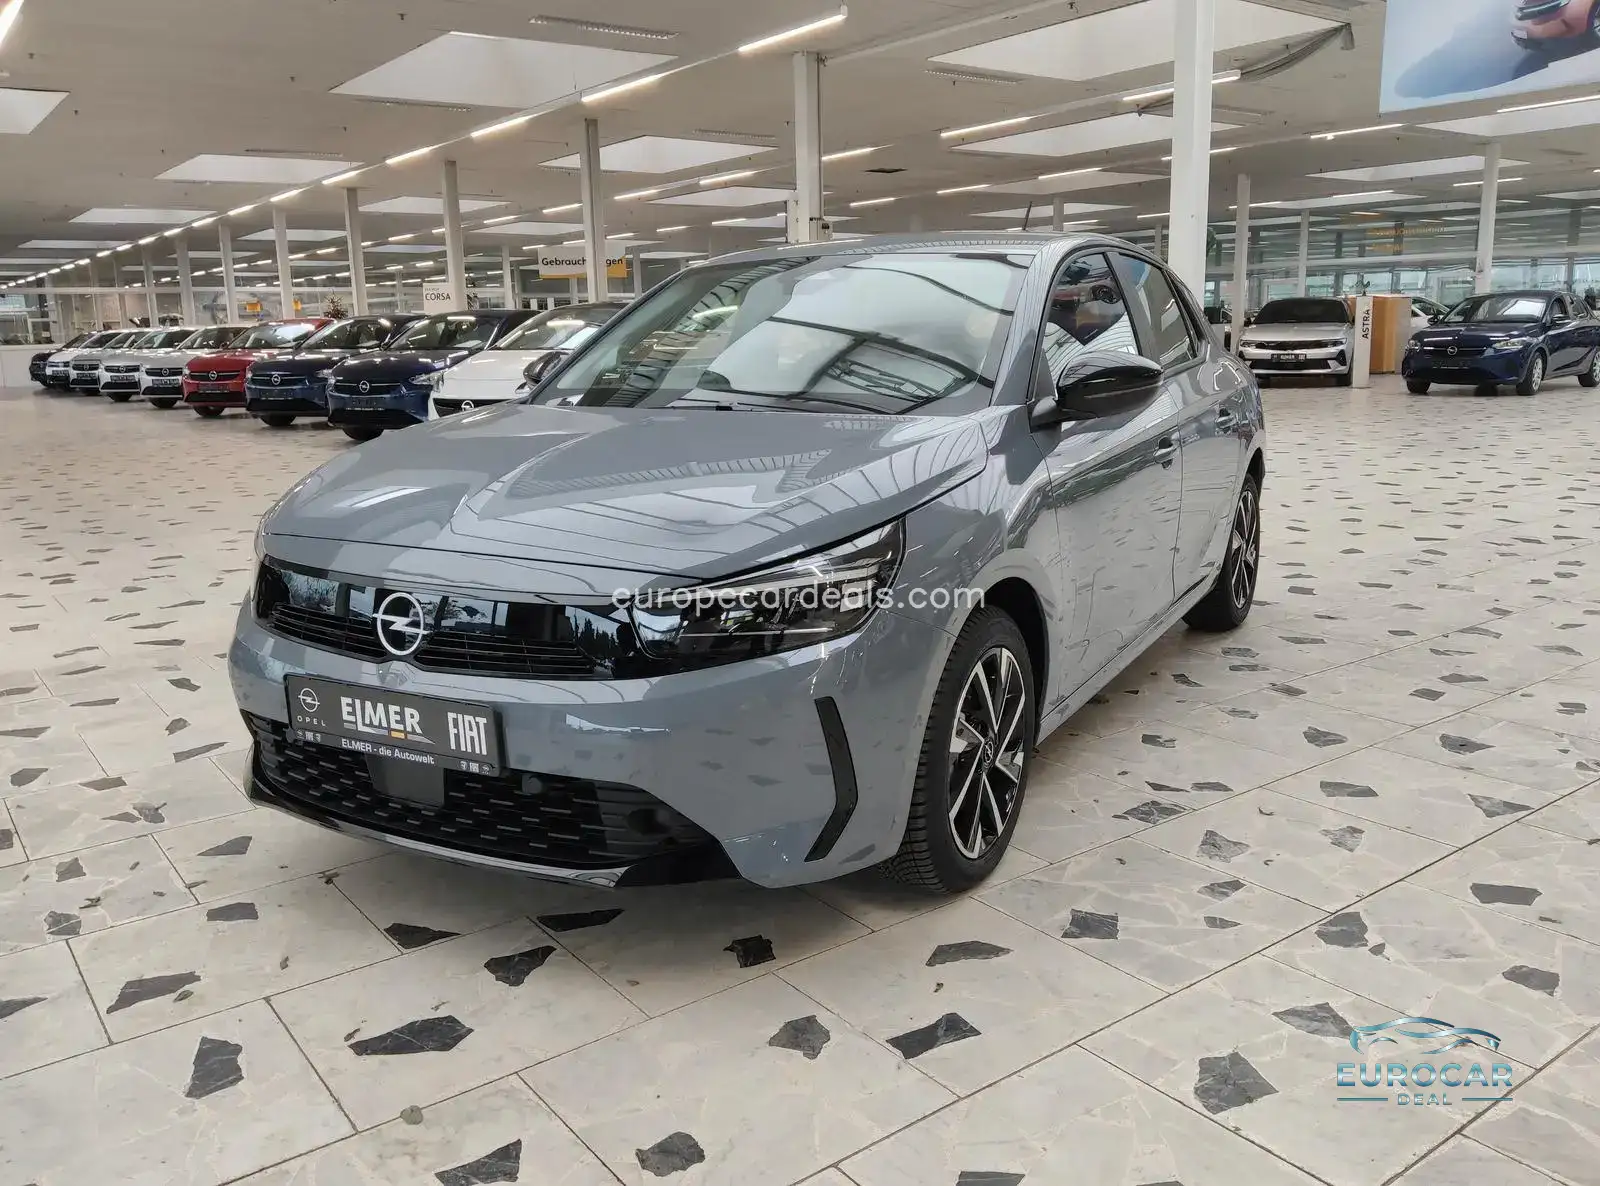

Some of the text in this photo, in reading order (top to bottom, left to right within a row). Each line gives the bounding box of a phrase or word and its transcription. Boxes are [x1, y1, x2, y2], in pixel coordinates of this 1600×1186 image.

[425, 292, 451, 301] CORSA
[1361, 309, 1371, 340] ASTRA
[297, 715, 326, 727] OPEL
[340, 696, 423, 735] ELMER
[446, 711, 488, 756] FIAT
[341, 738, 372, 753] ELMER
[379, 746, 392, 758] die
[394, 748, 435, 765] Autowelt
